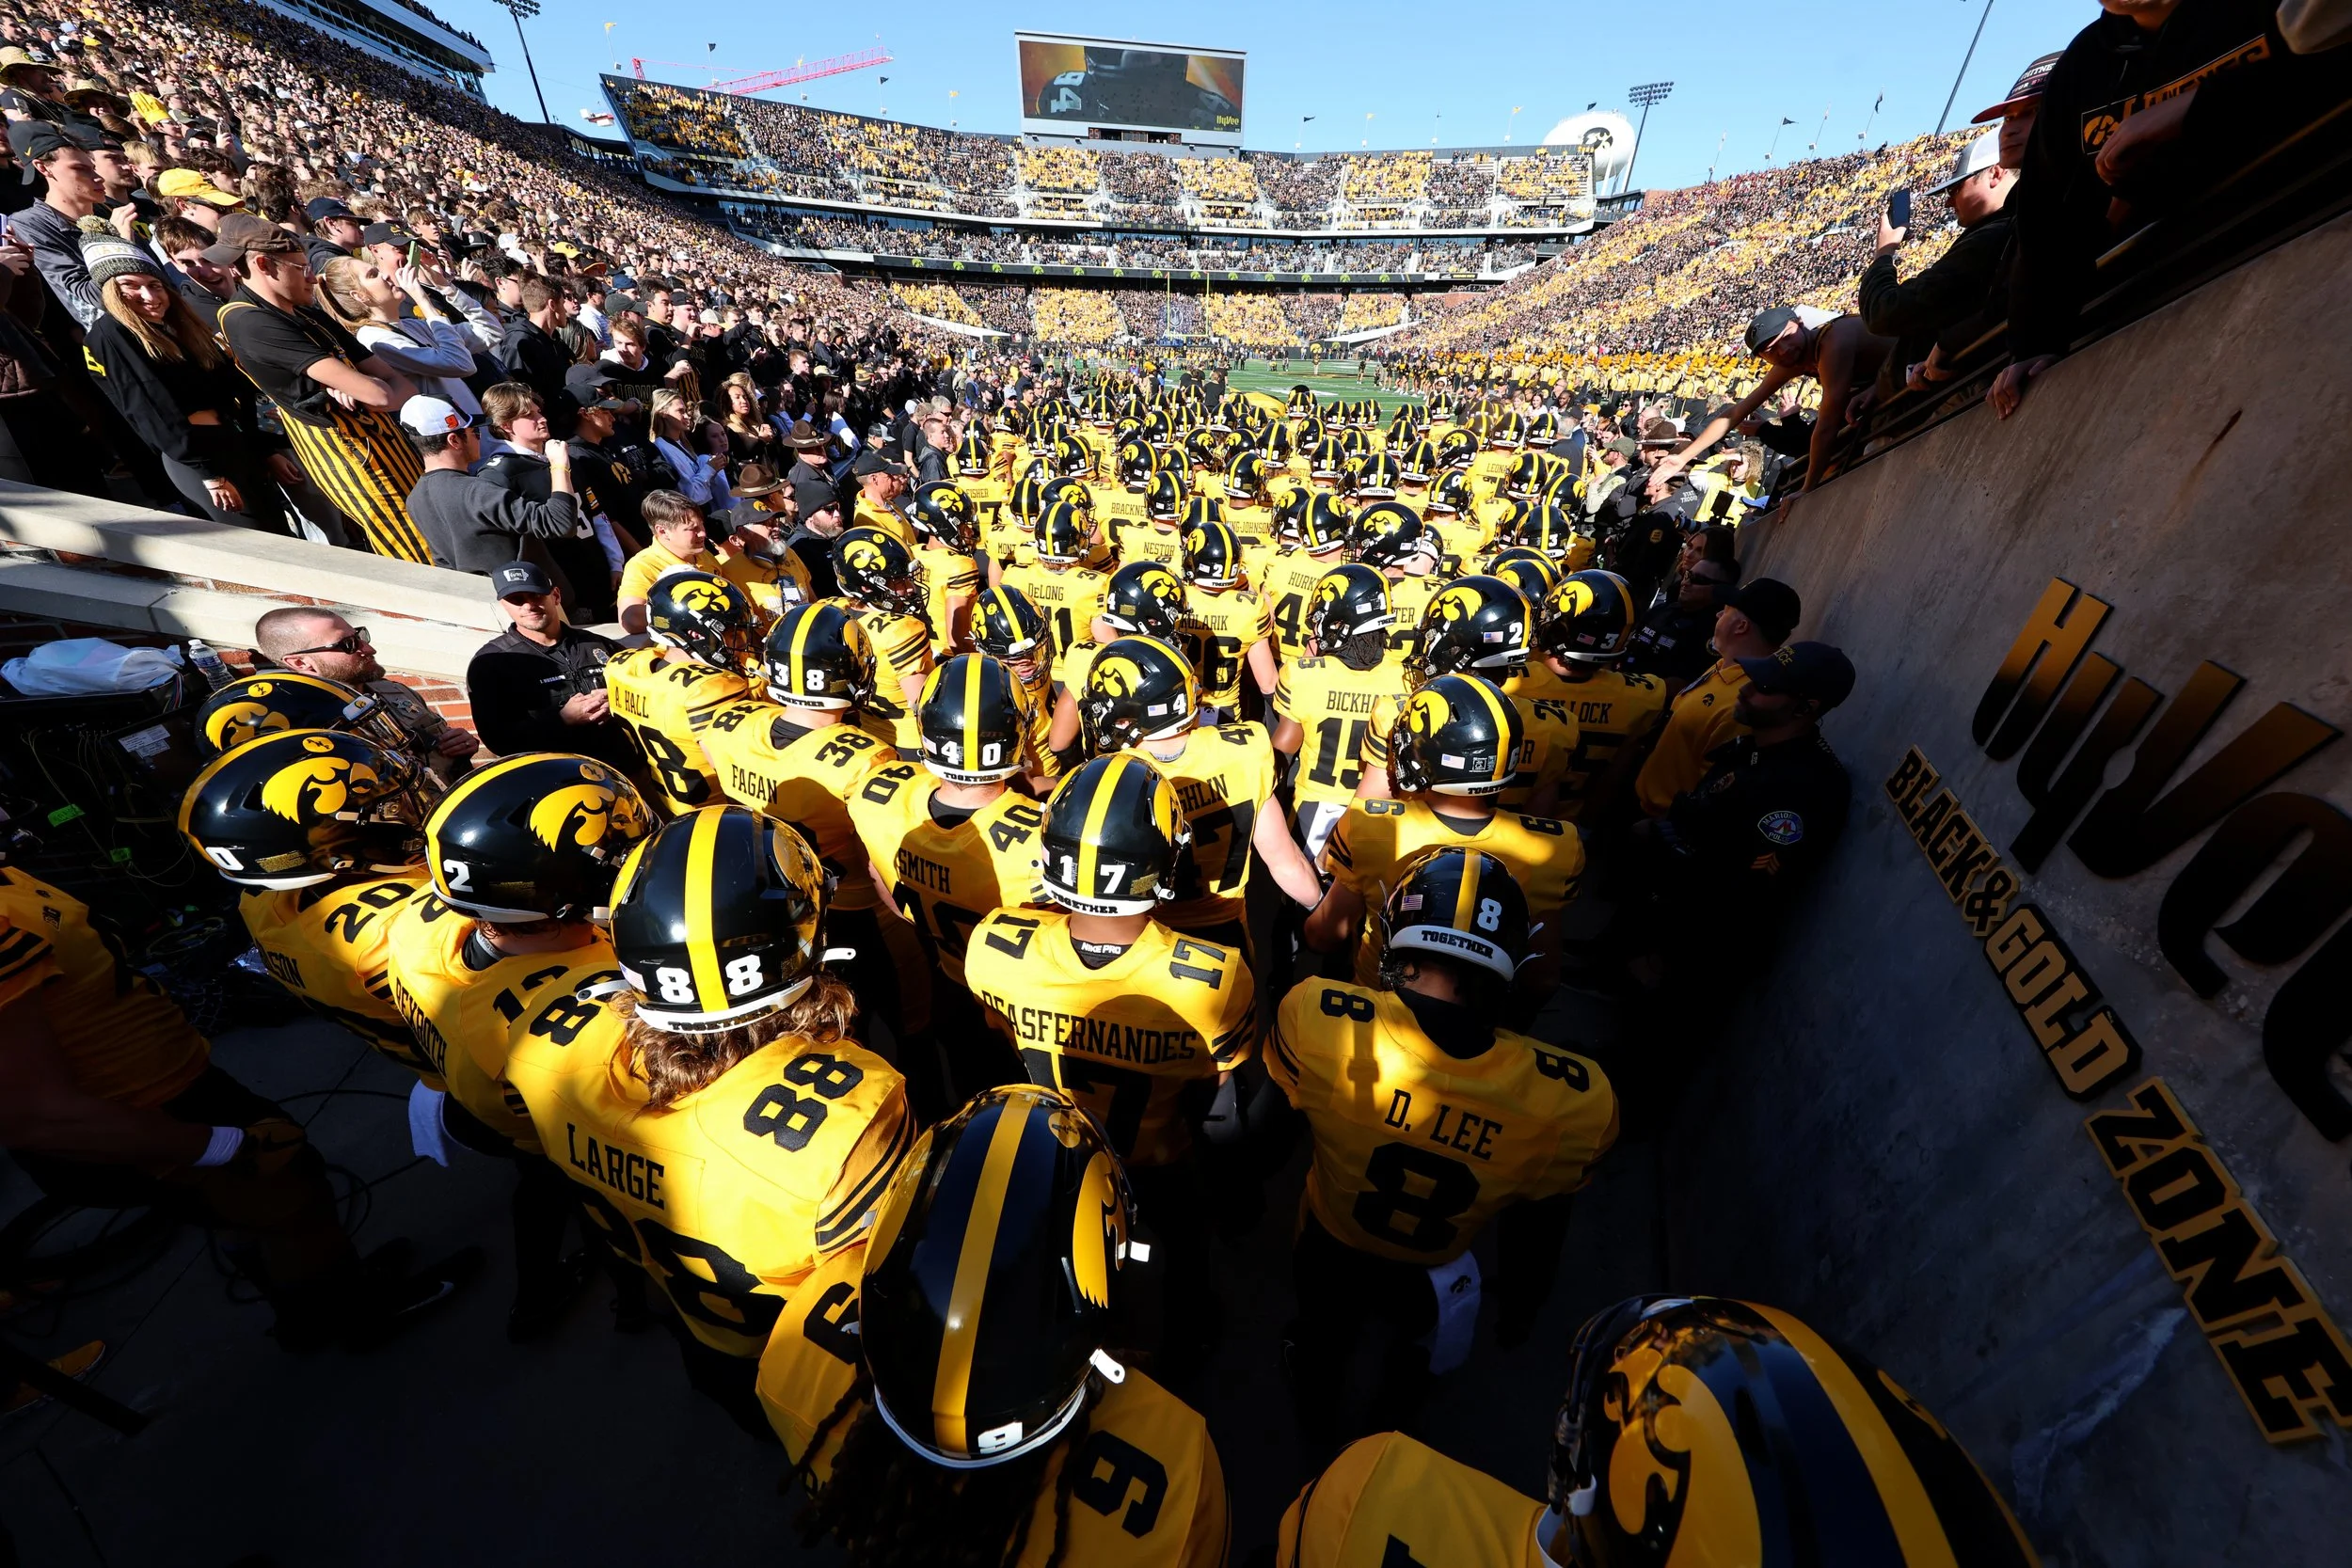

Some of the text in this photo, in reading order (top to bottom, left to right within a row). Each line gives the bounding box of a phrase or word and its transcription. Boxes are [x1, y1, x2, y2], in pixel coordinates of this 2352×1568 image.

[965, 458, 983, 468] 37
[965, 488, 990, 499] FISHER
[1368, 473, 1391, 485] 87
[1520, 483, 1541, 494] 45
[1111, 501, 1146, 516] BRACKNE
[997, 543, 1018, 555] MONT
[1039, 538, 1061, 554] 31
[1143, 541, 1176, 557] NESTOR
[1303, 529, 1328, 546] 49
[1548, 533, 1558, 547] 3
[1211, 563, 1238, 578] 26
[1288, 571, 1318, 592] HURK
[1027, 582, 1064, 602] DeLONG
[1180, 613, 1229, 631] KOLARIK
[1393, 607, 1415, 624] TER
[1508, 622, 1524, 645] 2
[1600, 633, 1619, 650] 3
[668, 663, 723, 688] 28
[774, 661, 825, 690] 38
[614, 686, 649, 719] A. HALL
[776, 692, 825, 707] TOGETHER
[1172, 692, 1187, 715] 4
[815, 733, 876, 768] 38
[941, 740, 1001, 767] 40
[1308, 717, 1364, 790] 15
[731, 763, 777, 804] FAGAN
[861, 764, 916, 805] 40
[943, 771, 1002, 783] TOGETHER
[1178, 773, 1230, 812] GHLIN
[988, 803, 1041, 852] 40
[443, 860, 474, 894] 2
[898, 846, 951, 895] SMITH
[1060, 854, 1126, 895] 17
[325, 881, 414, 943] 20
[1052, 891, 1119, 914] TOGETHER
[1476, 896, 1502, 932] 8
[985, 912, 1041, 959] 17
[1081, 942, 1122, 955] NIKE PRO
[1421, 929, 1494, 959] TOGETHER
[1168, 938, 1227, 990] 17
[658, 954, 764, 1005] 88
[668, 1006, 774, 1032] TOGETHER
[1319, 988, 1375, 1023] 8
[1532, 1047, 1590, 1093] 8
[742, 1053, 865, 1153] 88
[1384, 1088, 1503, 1161] D. LEE
[566, 1122, 665, 1212] LARGE
[1984, 905, 2137, 1099] GOLD
[2084, 1078, 2352, 1444] ZONE
[1351, 1141, 1481, 1253] 8
[977, 1421, 1024, 1454] 9
[1073, 1430, 1169, 1539] 9
